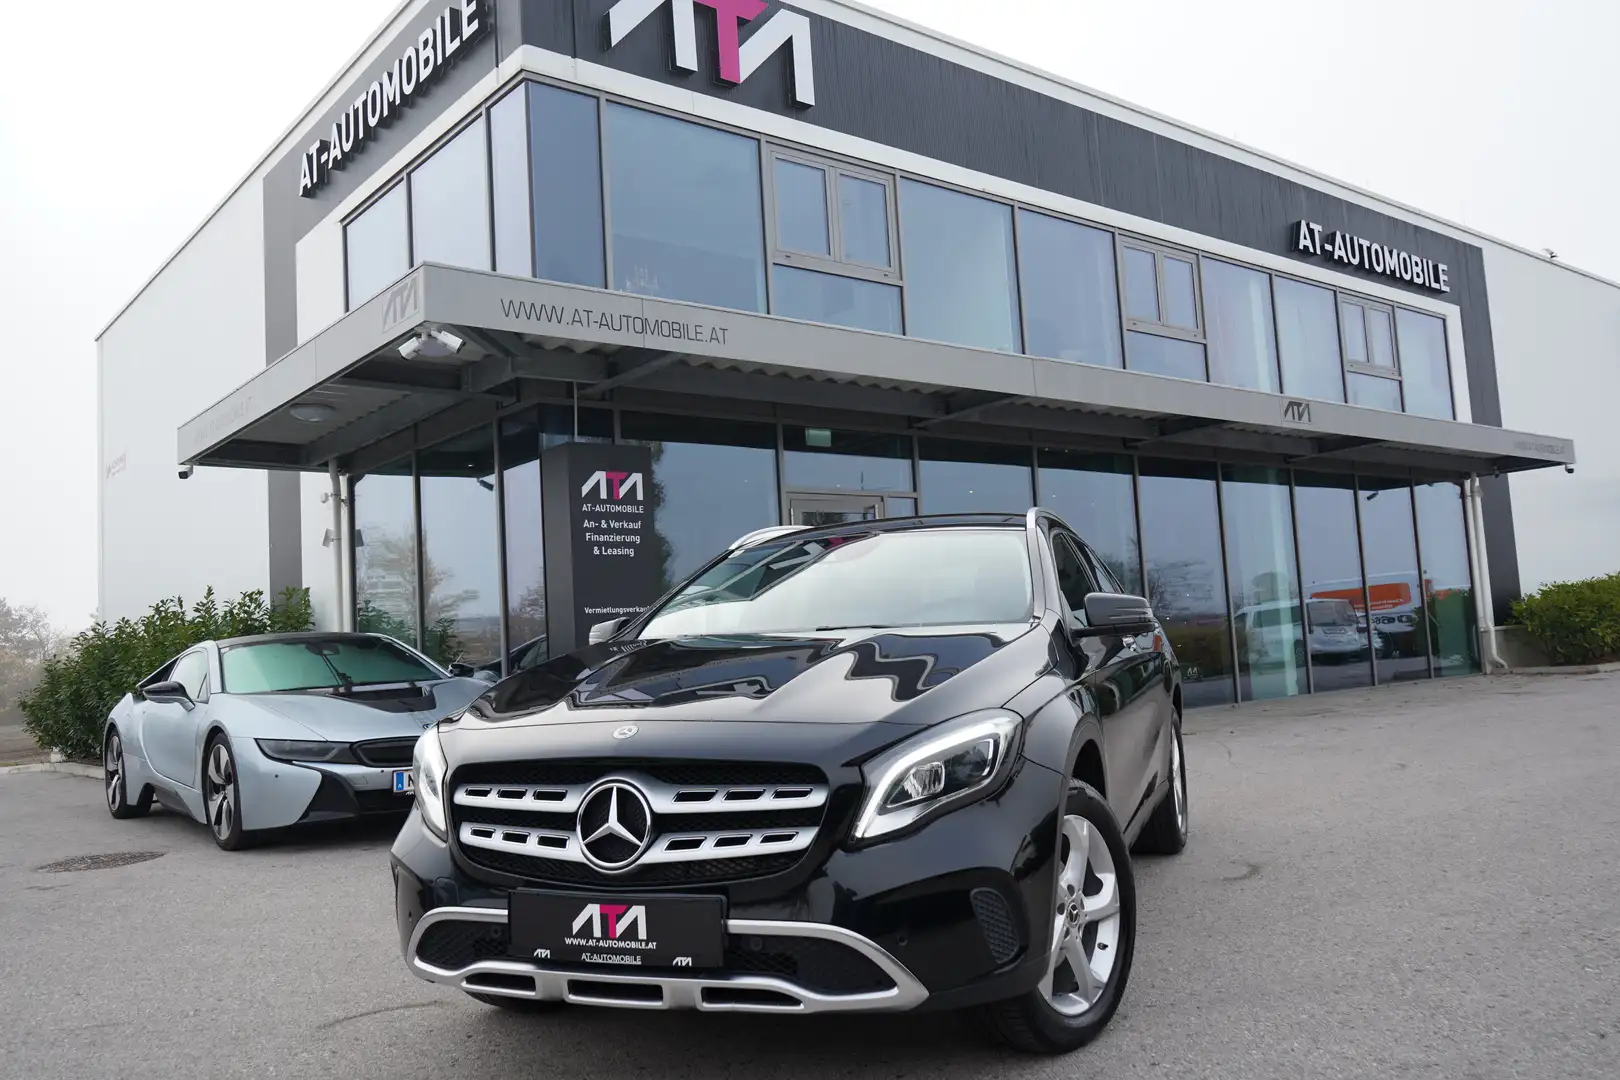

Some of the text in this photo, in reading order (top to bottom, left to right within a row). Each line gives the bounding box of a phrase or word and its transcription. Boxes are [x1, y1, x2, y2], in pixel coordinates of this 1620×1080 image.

[299, 0, 479, 197] AT-AUTOMOBILE
[1297, 218, 1450, 293] AT-AUTOMOBILE
[500, 298, 729, 346] WWW.AT-AUTOMOBILE.AT
[581, 503, 645, 514] AT-AUTOMOBILE
[583, 519, 642, 530] An- & Verkauf
[585, 532, 641, 544] Finanzierung
[593, 546, 635, 557] & Leasing
[564, 937, 657, 950] WWW.AT-AUTOMOBILE.AT
[581, 952, 642, 965] AT-AUTOMOBILE
